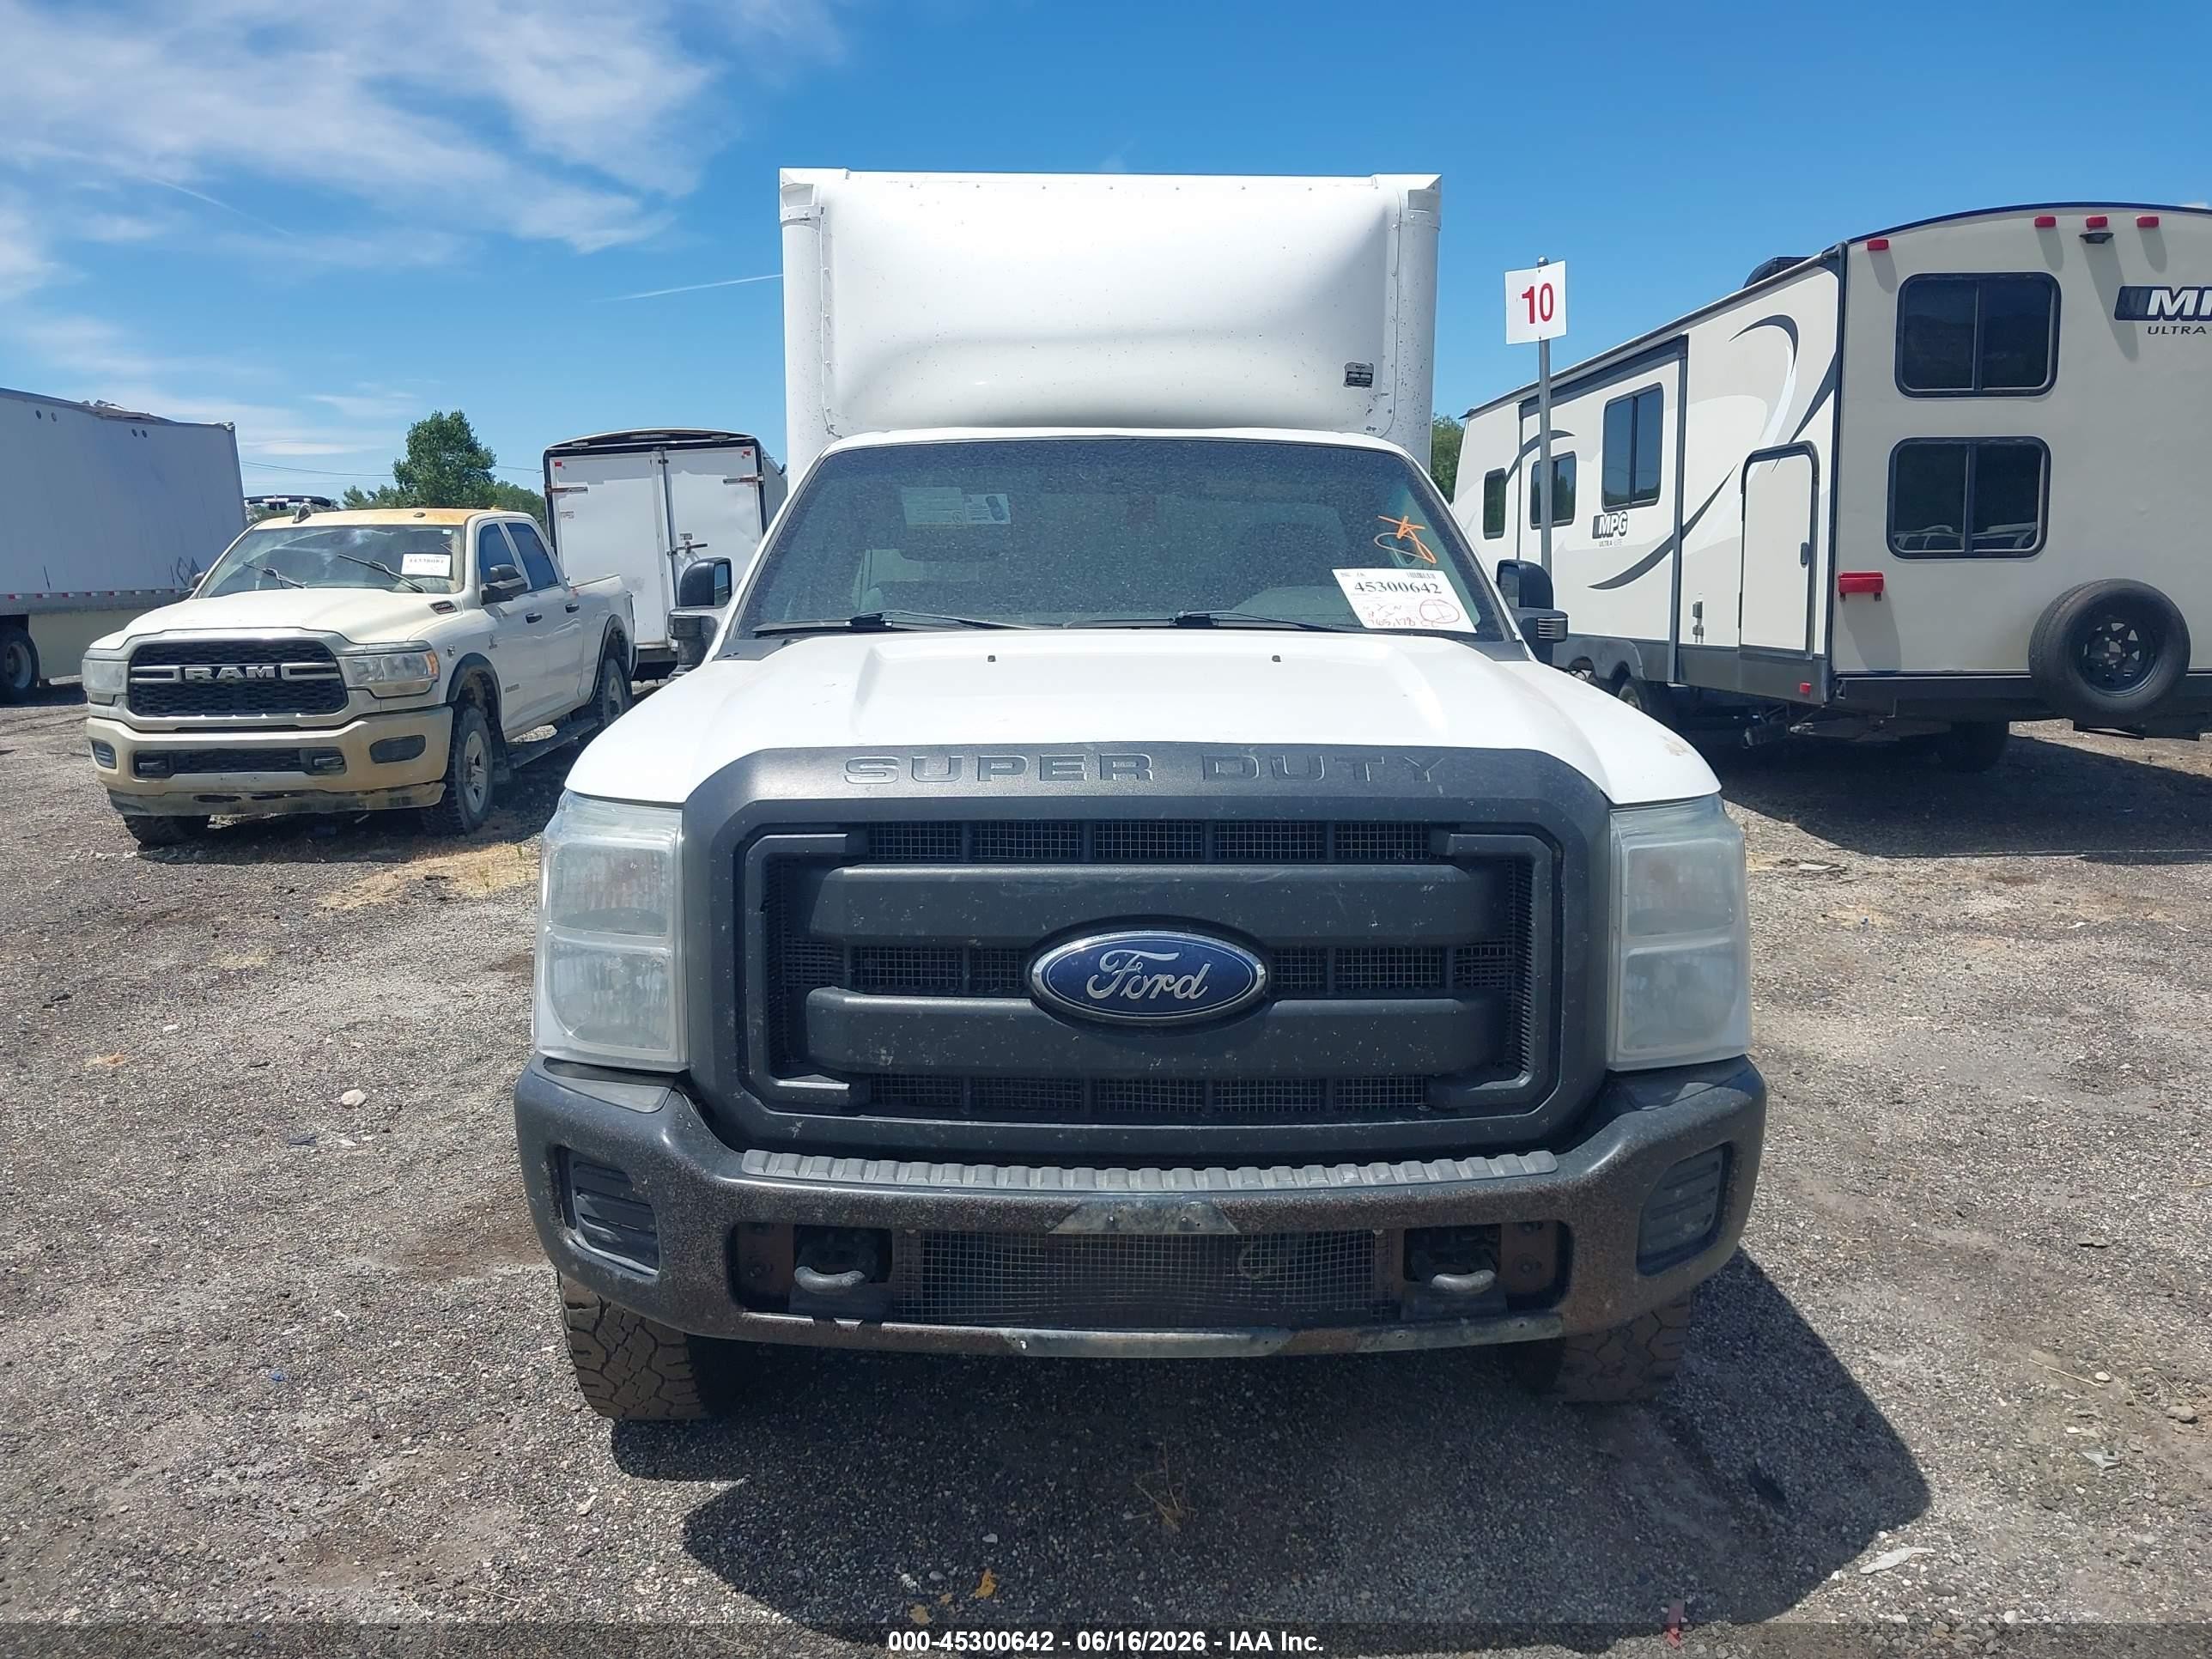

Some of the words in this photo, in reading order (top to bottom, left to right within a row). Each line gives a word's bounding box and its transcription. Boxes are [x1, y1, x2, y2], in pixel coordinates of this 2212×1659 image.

[1522, 283, 1554, 324] 10
[1598, 511, 1628, 536] MPG
[1354, 580, 1443, 595] 45300642
[185, 665, 276, 680] RAM
[844, 753, 1154, 785] SUPER
[1201, 755, 1445, 782] DUTY
[1086, 949, 1212, 1000] Ford
